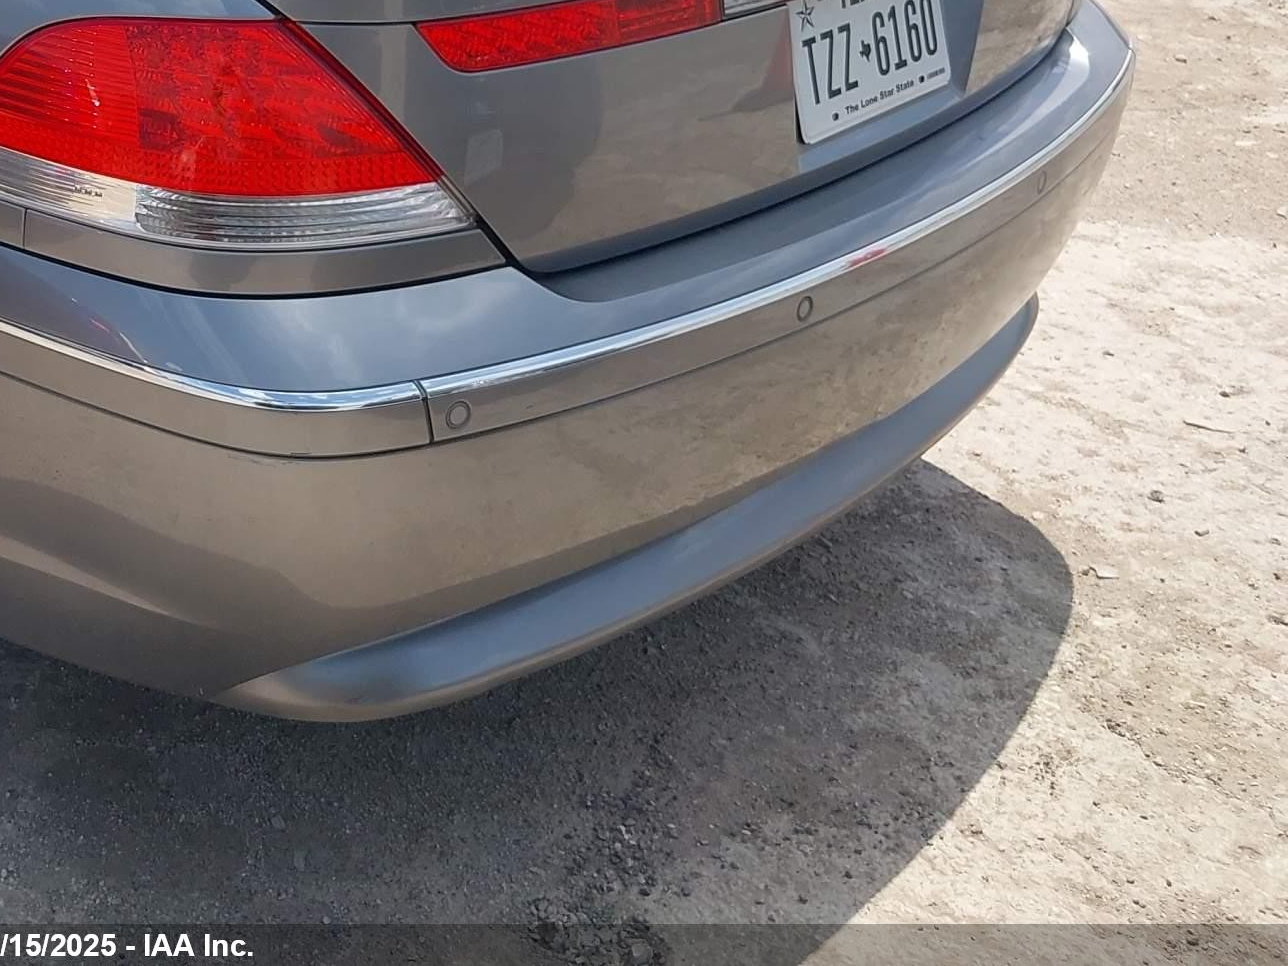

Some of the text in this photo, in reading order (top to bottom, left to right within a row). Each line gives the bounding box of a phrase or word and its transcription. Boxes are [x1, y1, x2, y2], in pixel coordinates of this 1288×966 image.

[845, 80, 914, 115] The Lone Star State
